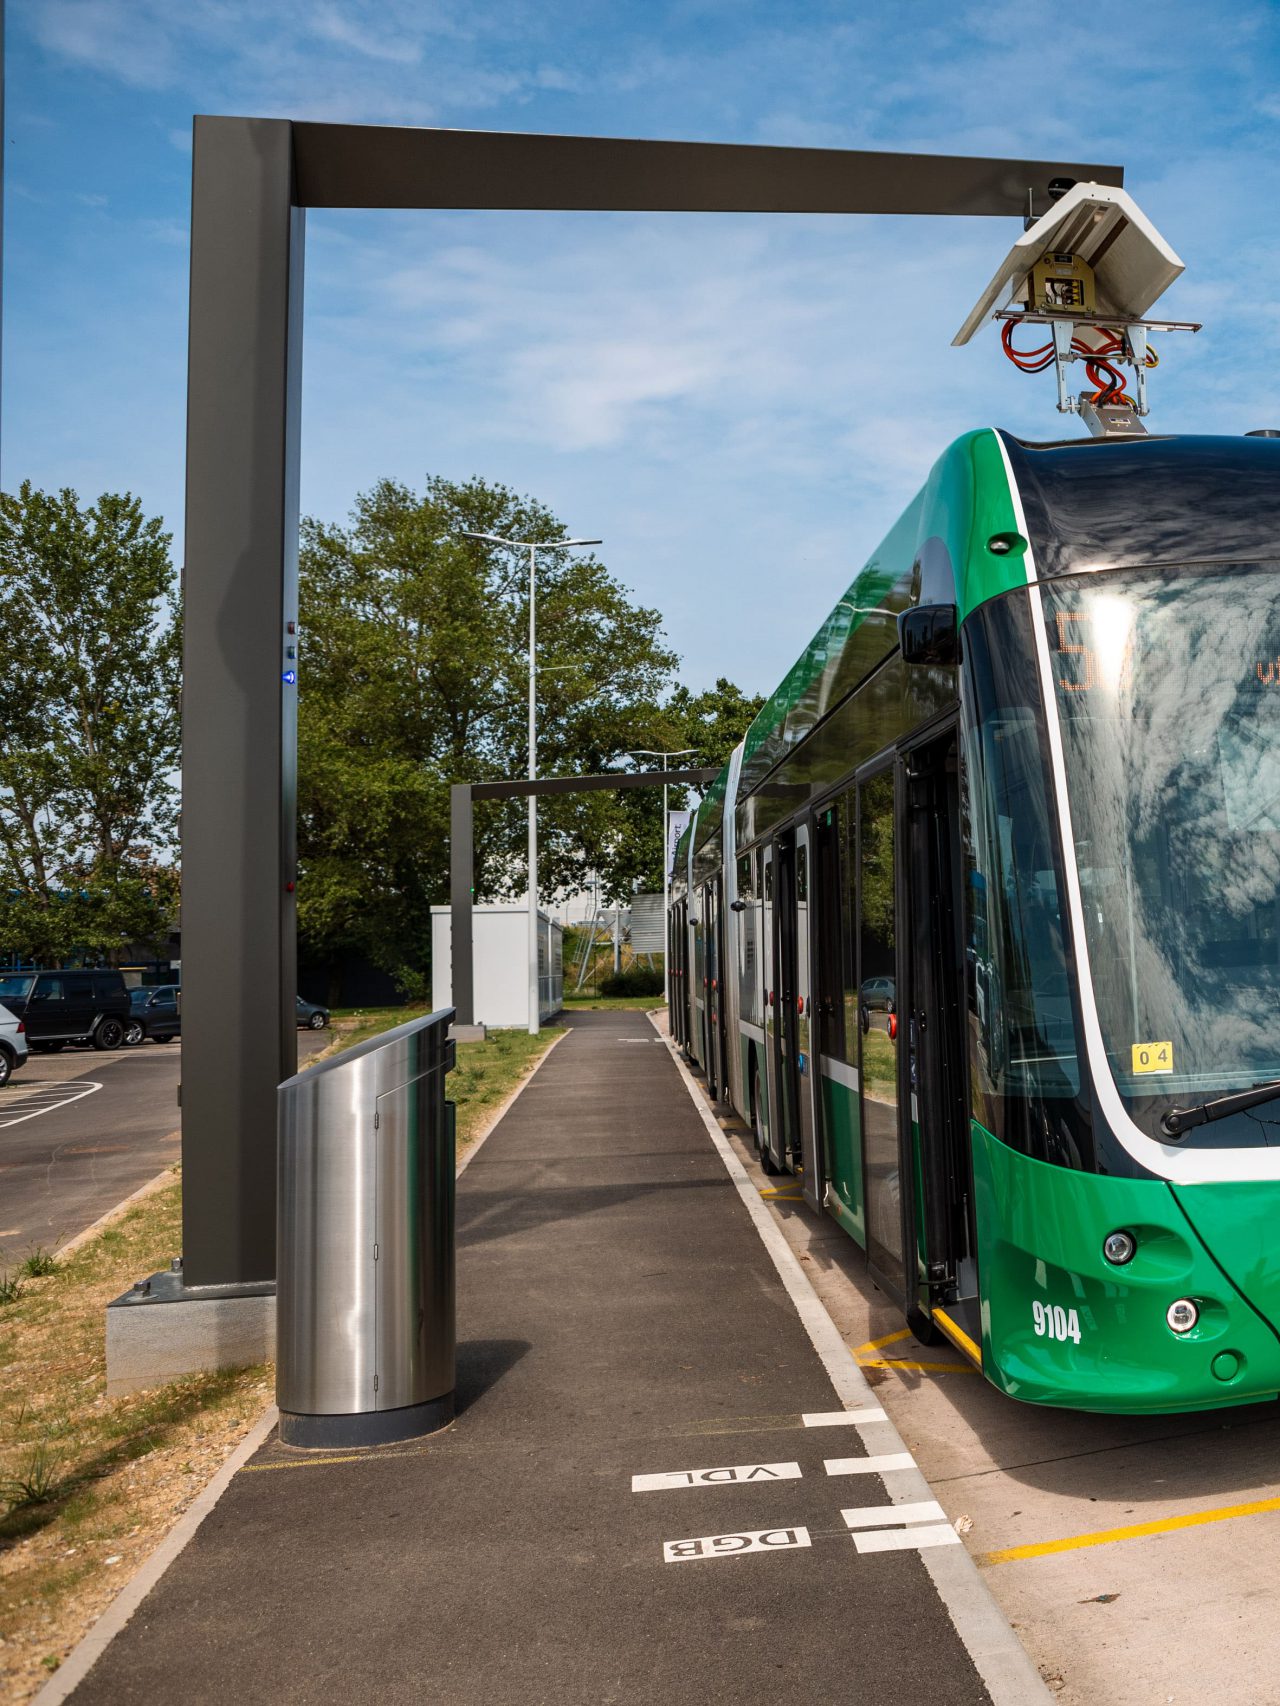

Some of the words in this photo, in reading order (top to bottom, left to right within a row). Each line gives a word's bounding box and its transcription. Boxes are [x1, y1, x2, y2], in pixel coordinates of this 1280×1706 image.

[1032, 1300, 1081, 1345] 9104
[666, 1466, 780, 1484] VDL
[669, 1530, 799, 1557] DGB
